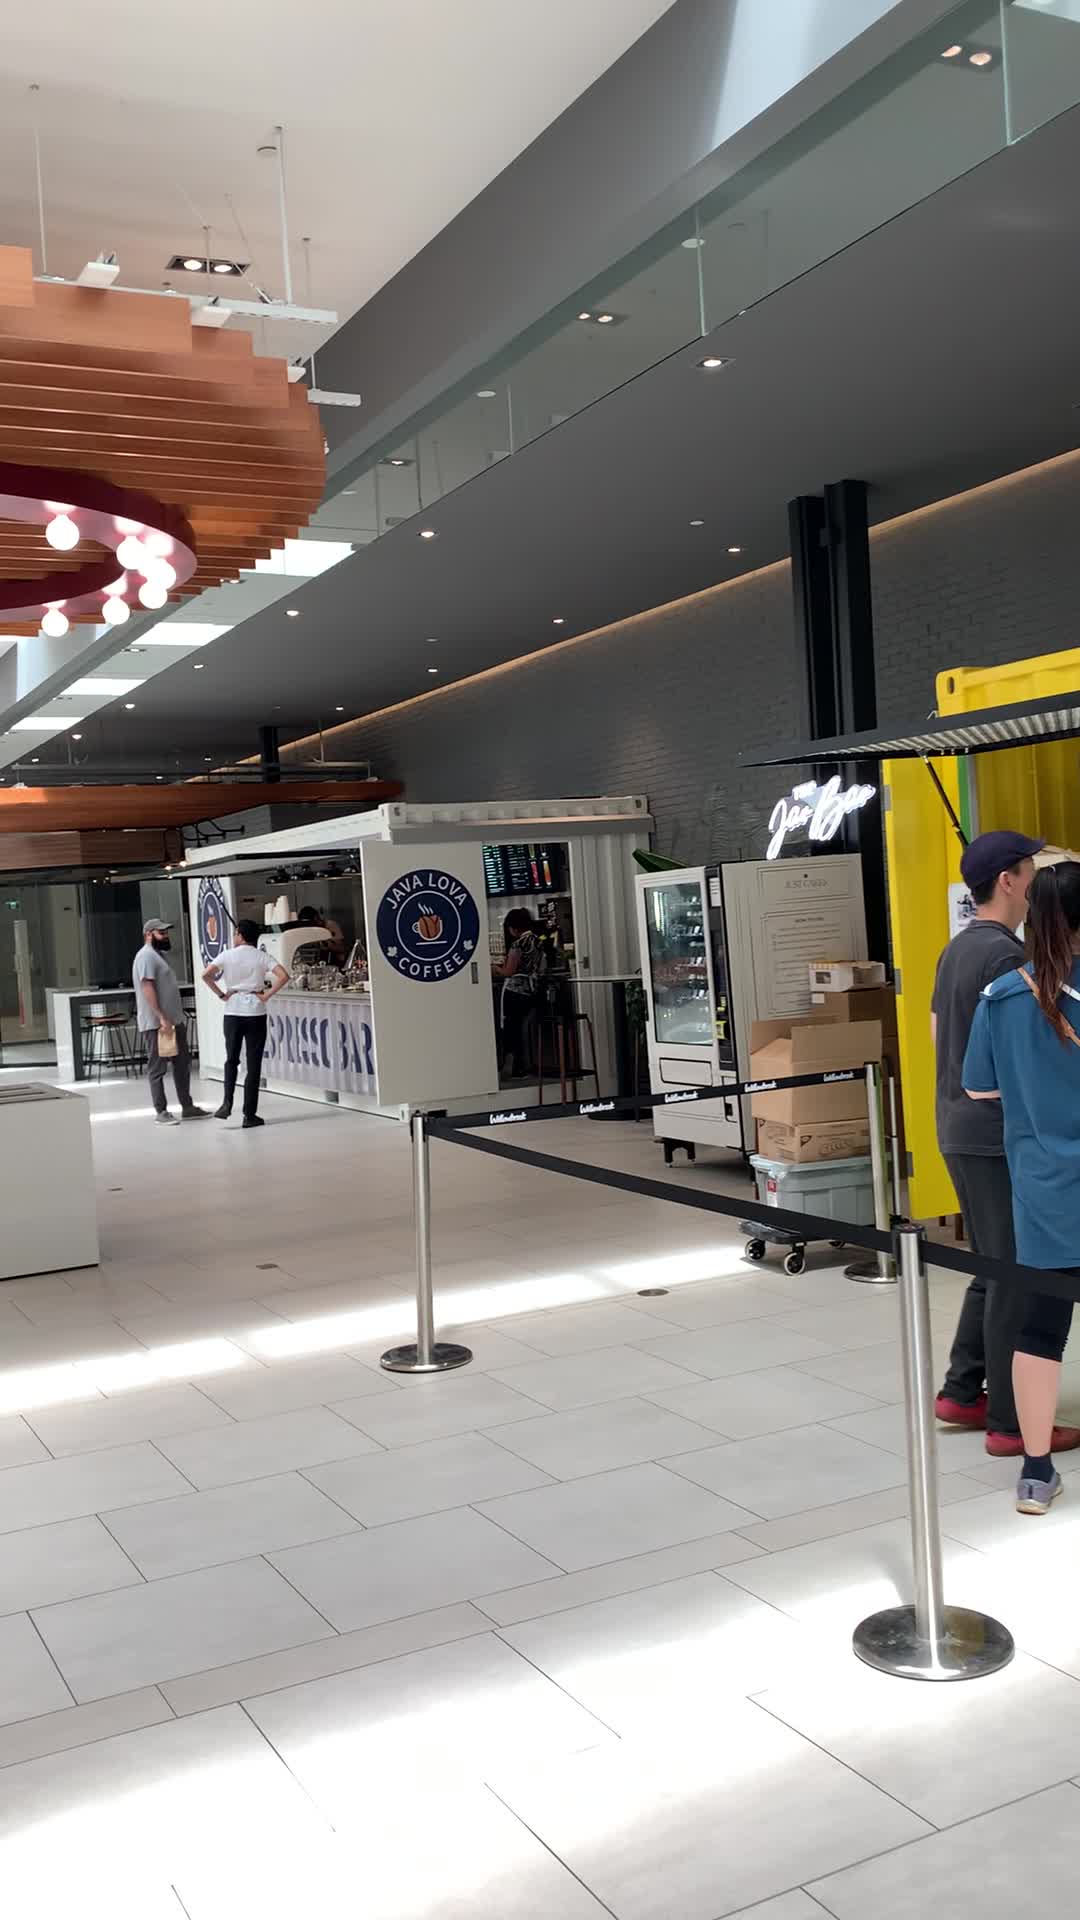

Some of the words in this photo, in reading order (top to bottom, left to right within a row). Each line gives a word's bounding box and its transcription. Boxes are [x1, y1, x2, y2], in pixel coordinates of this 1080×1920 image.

[386, 874, 424, 909] JAVA
[427, 873, 468, 906] LOVA
[398, 952, 465, 978] COFFEE
[338, 1021, 375, 1076] BAR
